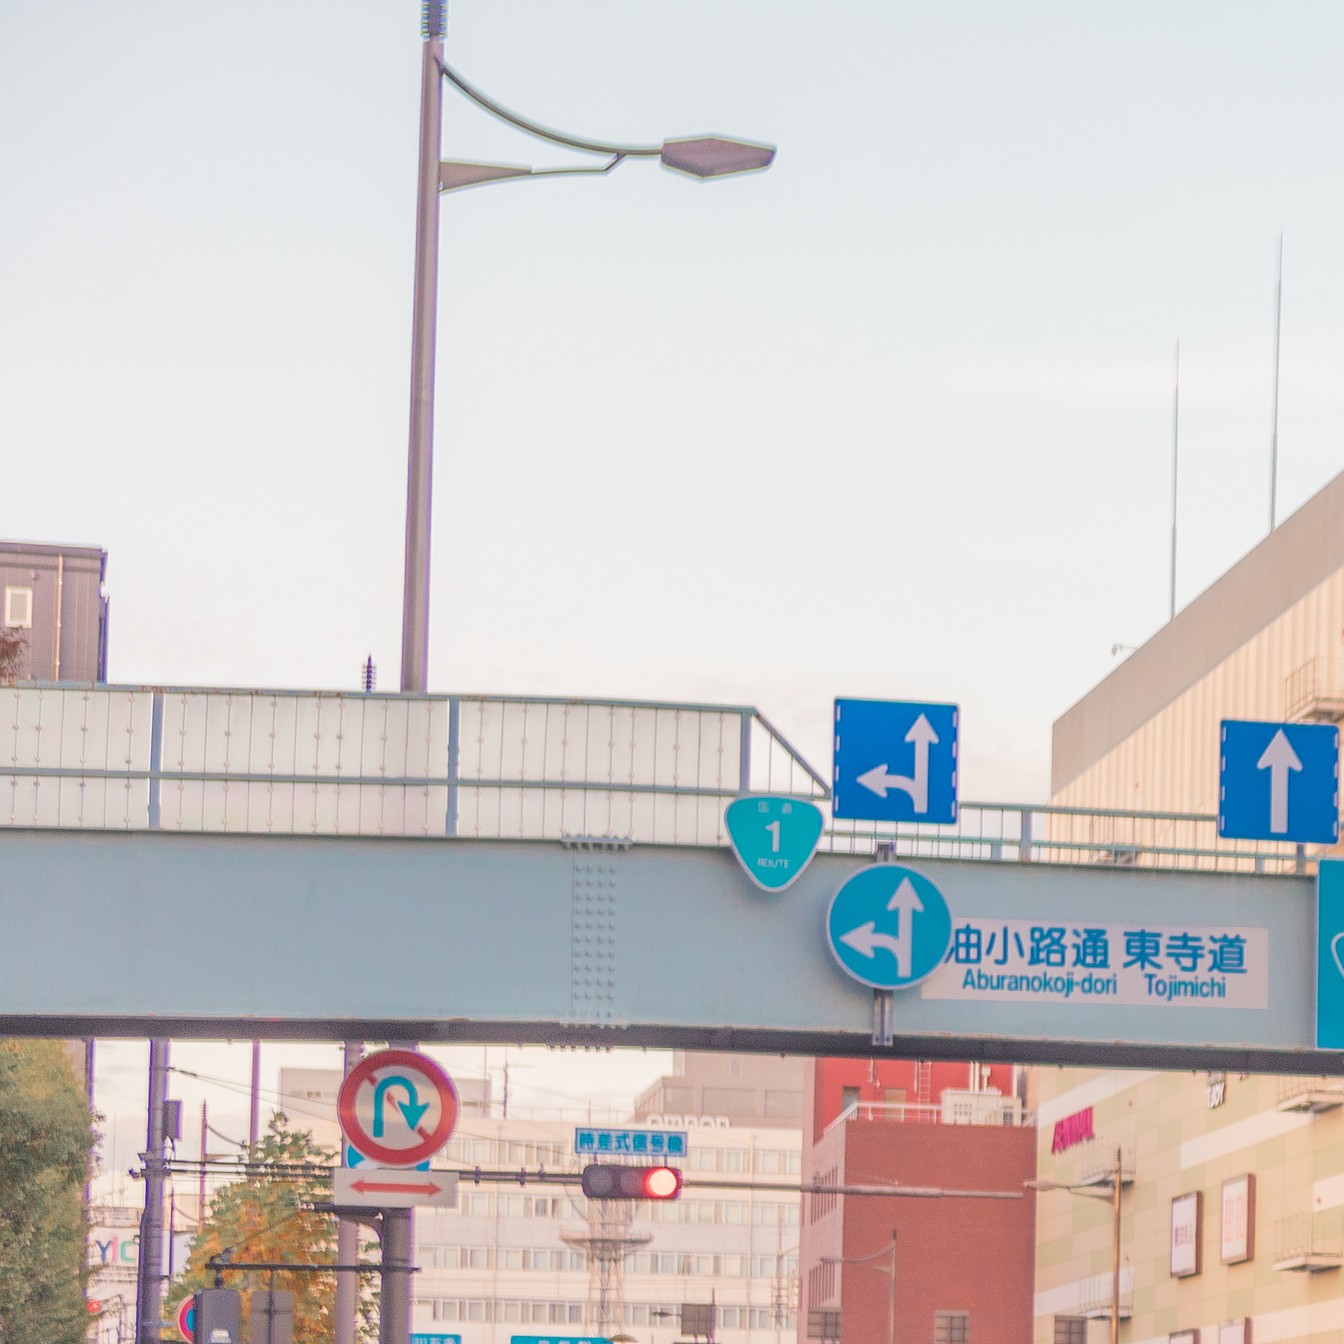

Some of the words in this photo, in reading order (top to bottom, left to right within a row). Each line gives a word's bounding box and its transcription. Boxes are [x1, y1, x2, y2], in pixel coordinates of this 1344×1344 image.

[765, 820, 780, 853] 1
[1122, 929, 1248, 974] 東寺道
[962, 969, 1118, 998] Aburanokoji-dori
[1144, 973, 1227, 1001] Tojimichi
